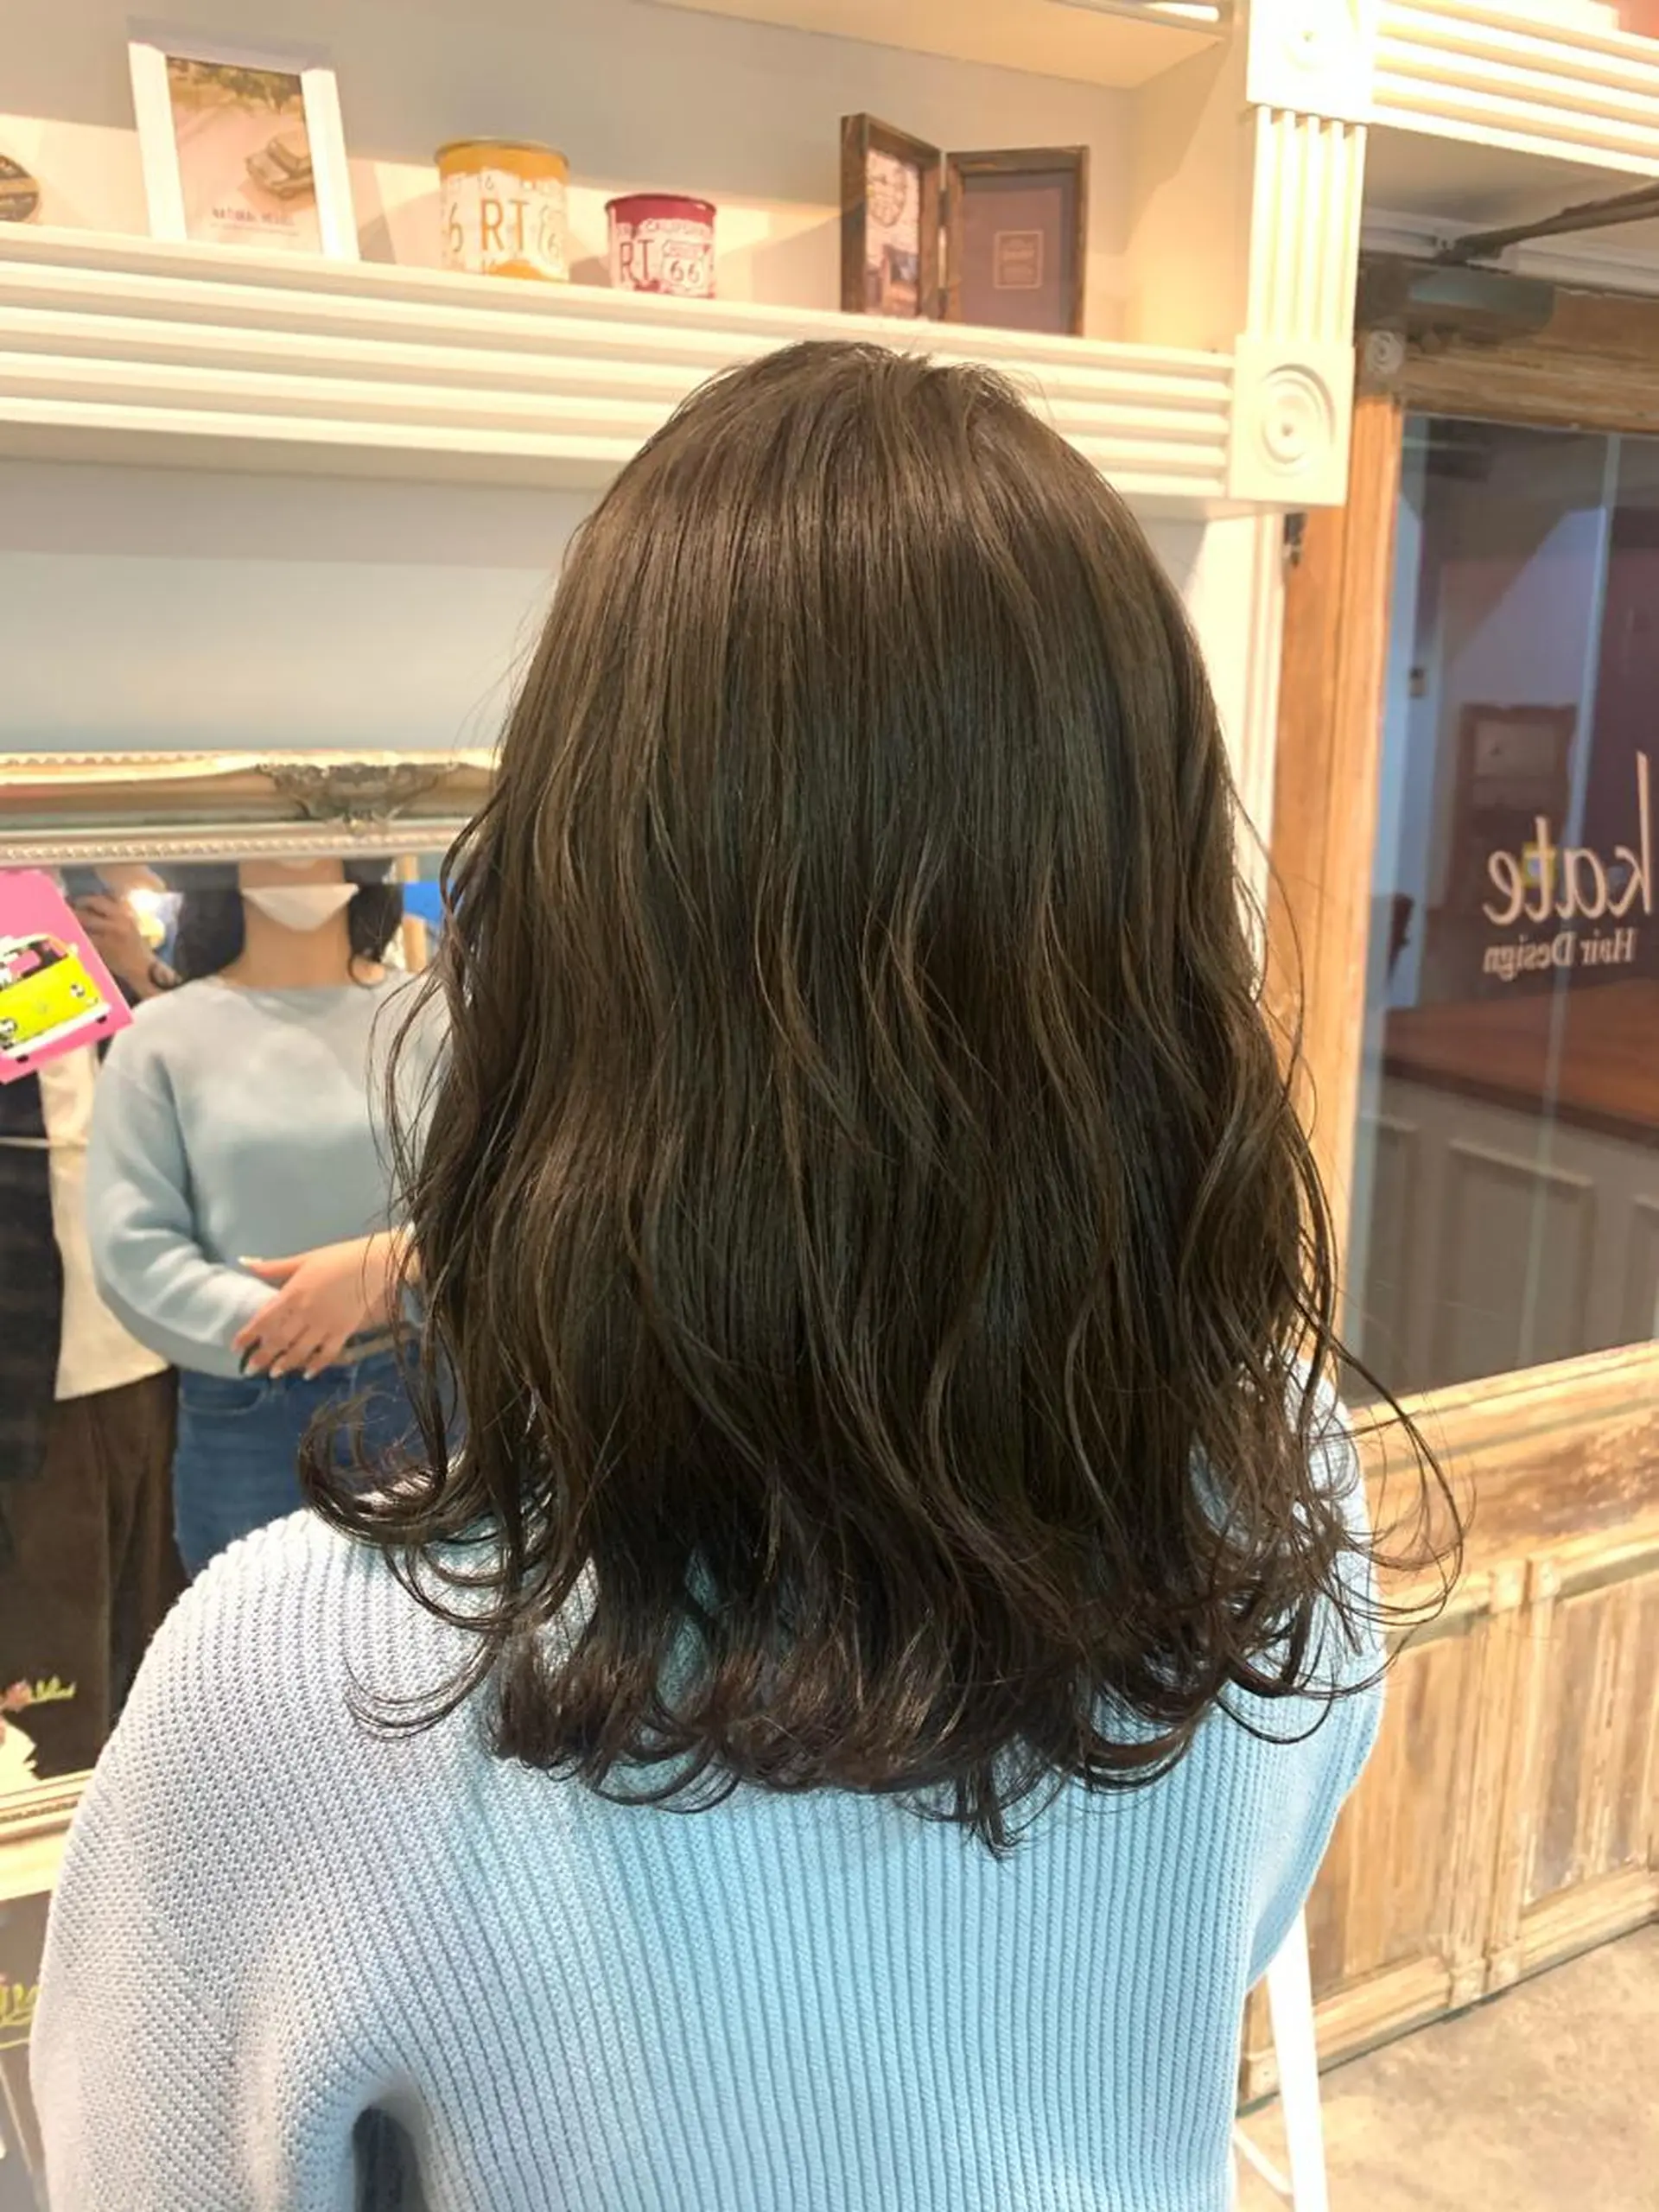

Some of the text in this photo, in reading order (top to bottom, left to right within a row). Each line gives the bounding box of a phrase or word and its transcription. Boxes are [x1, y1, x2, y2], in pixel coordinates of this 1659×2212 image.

[480, 198, 531, 251] RT
[620, 238, 655, 283] RT
[670, 260, 701, 283] 66
